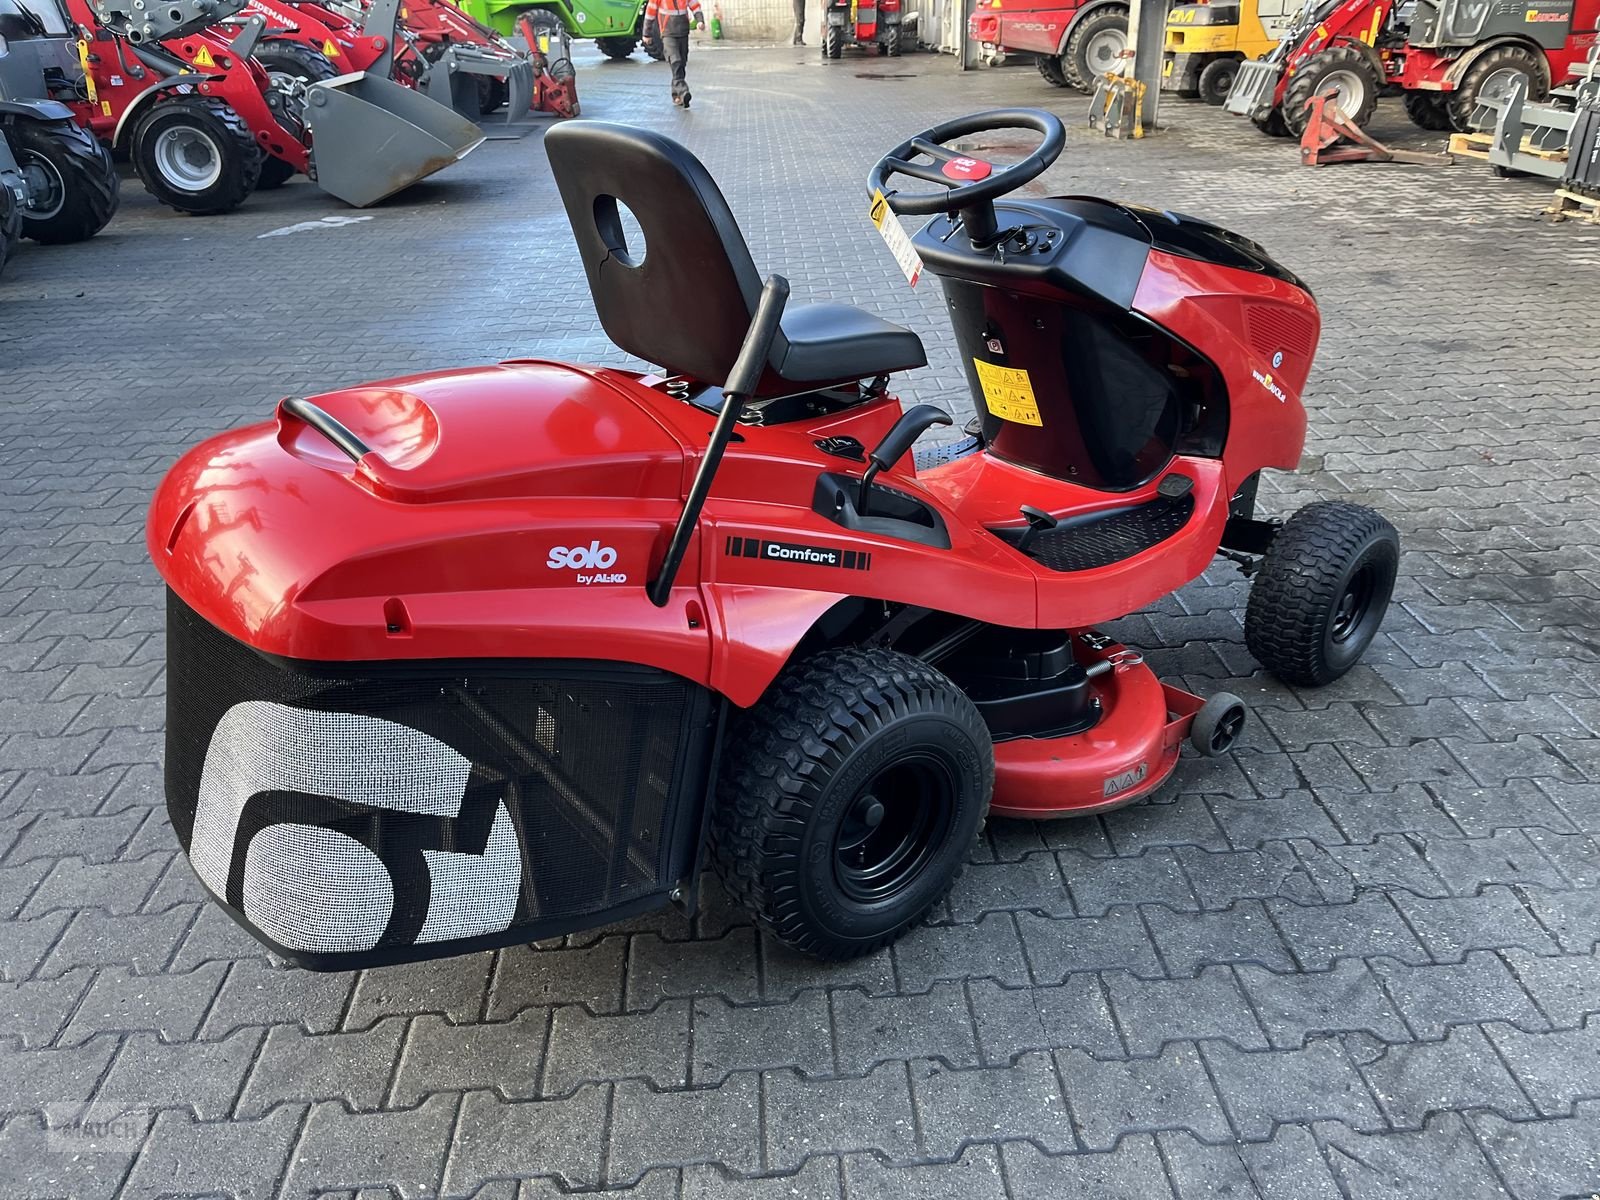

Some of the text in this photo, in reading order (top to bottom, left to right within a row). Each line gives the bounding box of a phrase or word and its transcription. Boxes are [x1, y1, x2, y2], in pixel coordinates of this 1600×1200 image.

[249, 0, 298, 29] EIDEMANN
[1168, 9, 1196, 23] CM
[546, 540, 617, 569] solo
[767, 544, 836, 564] Comfort
[577, 573, 627, 585] by AL-KO
